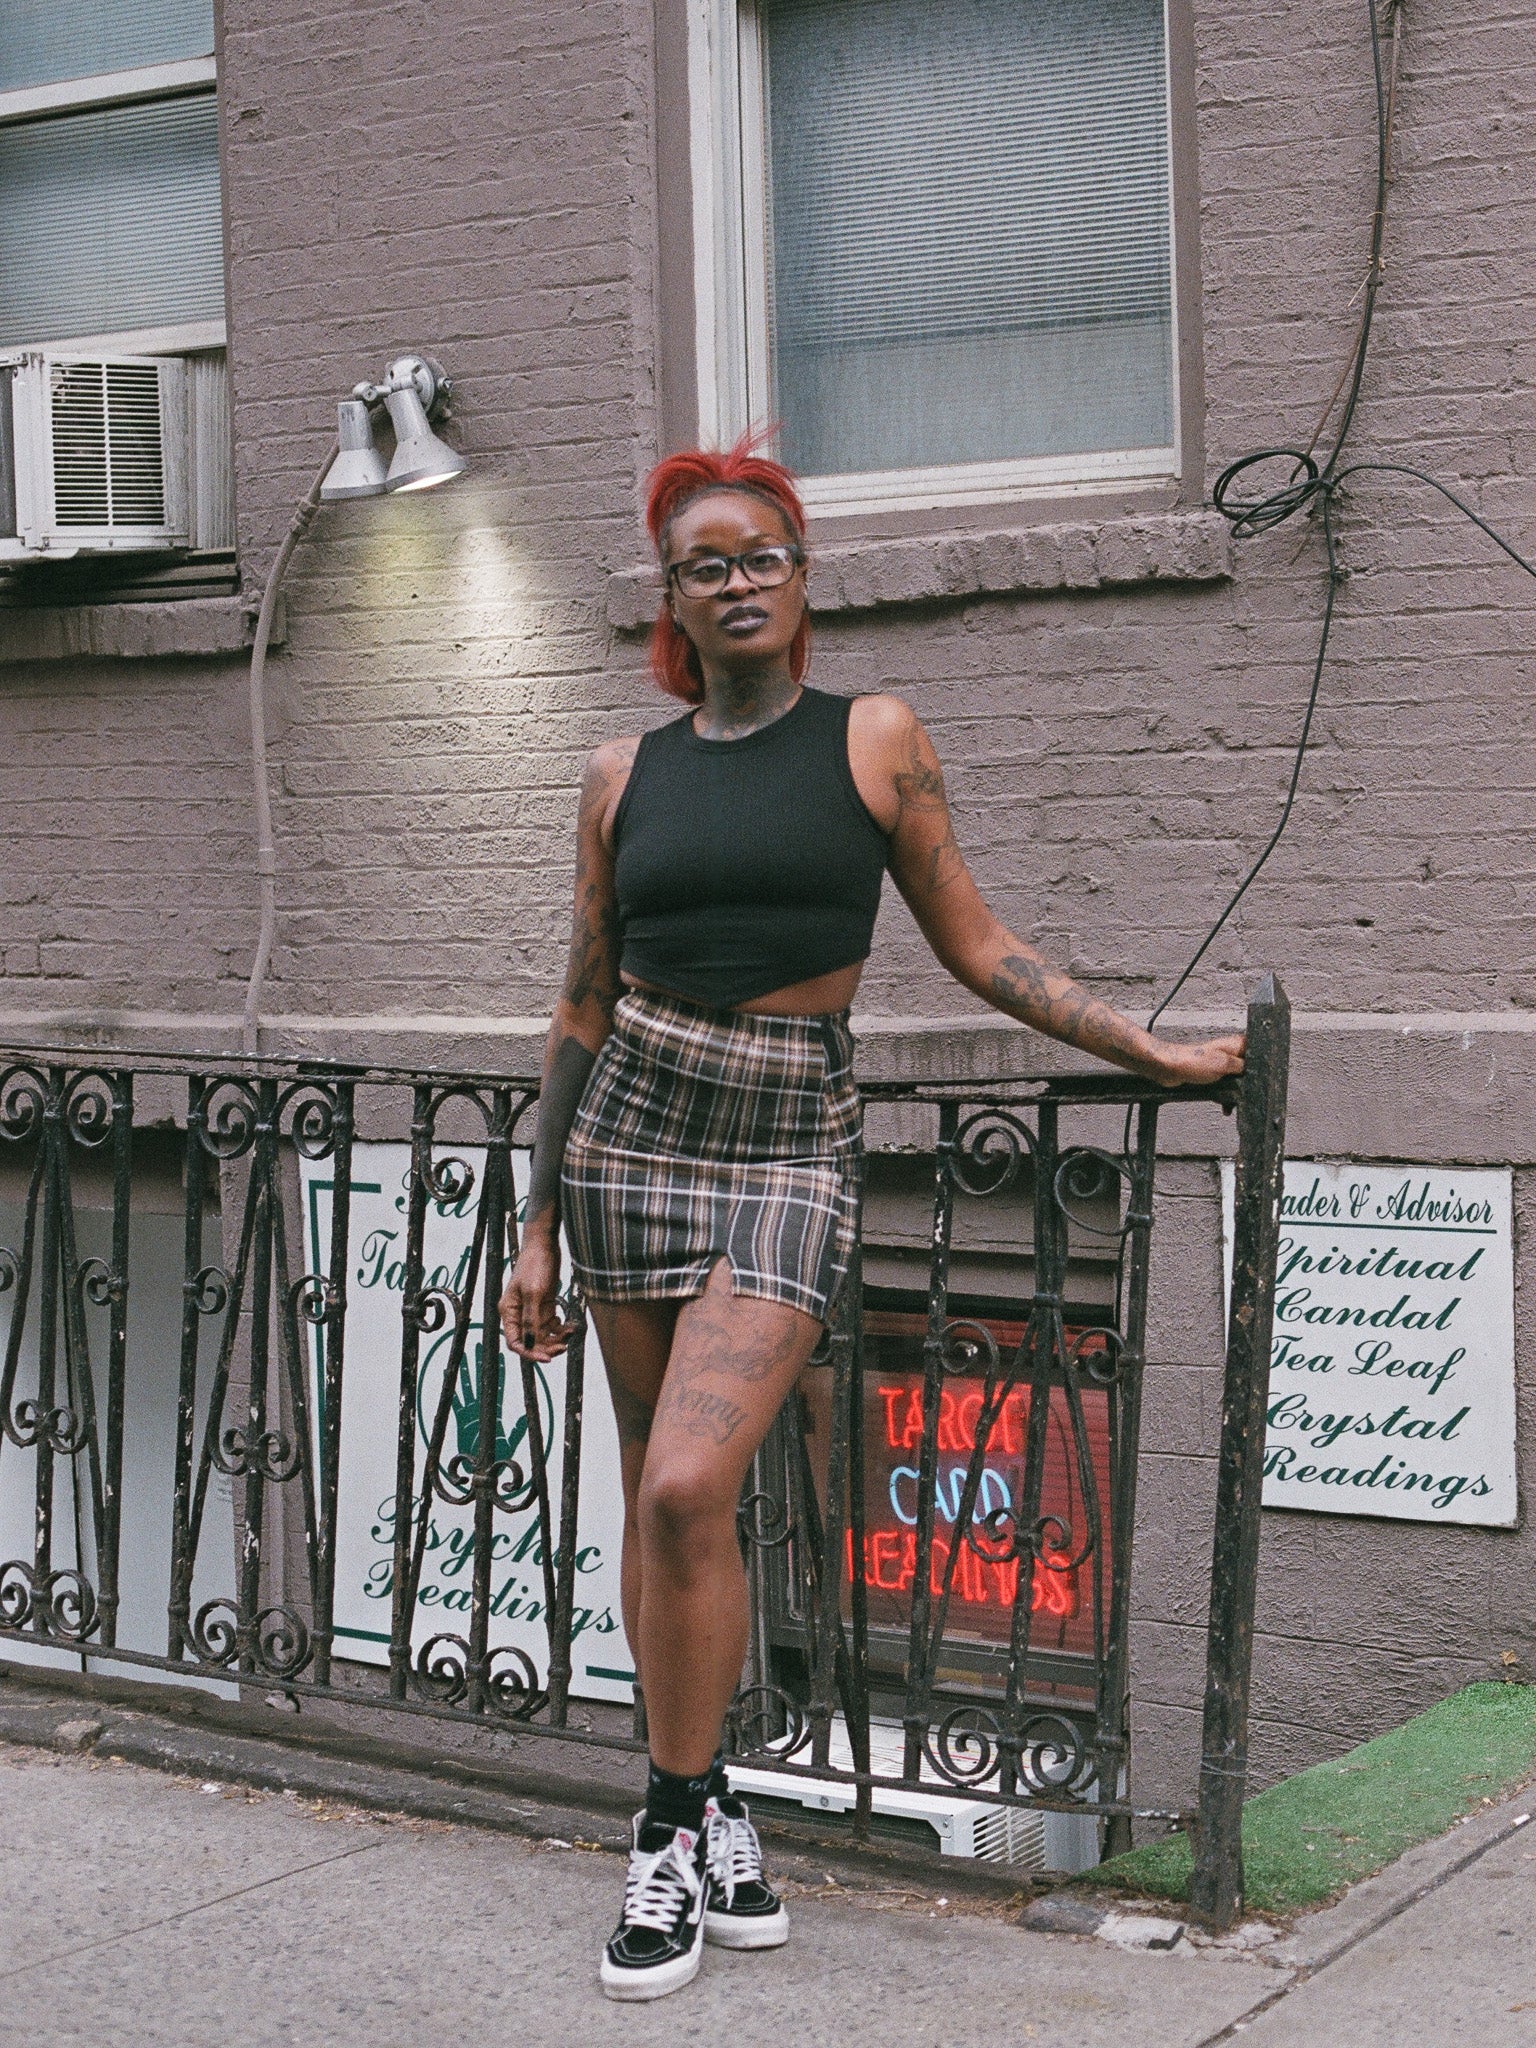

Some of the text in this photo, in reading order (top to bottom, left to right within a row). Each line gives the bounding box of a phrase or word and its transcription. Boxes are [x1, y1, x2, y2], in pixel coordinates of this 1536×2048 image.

[1280, 1177, 1494, 1224] ader & Advisor
[1274, 1287, 1461, 1331] Candal
[1270, 1334, 1467, 1395] Tea Leaf
[1267, 1391, 1471, 1448] Crystal
[1262, 1445, 1494, 1509] Readings
